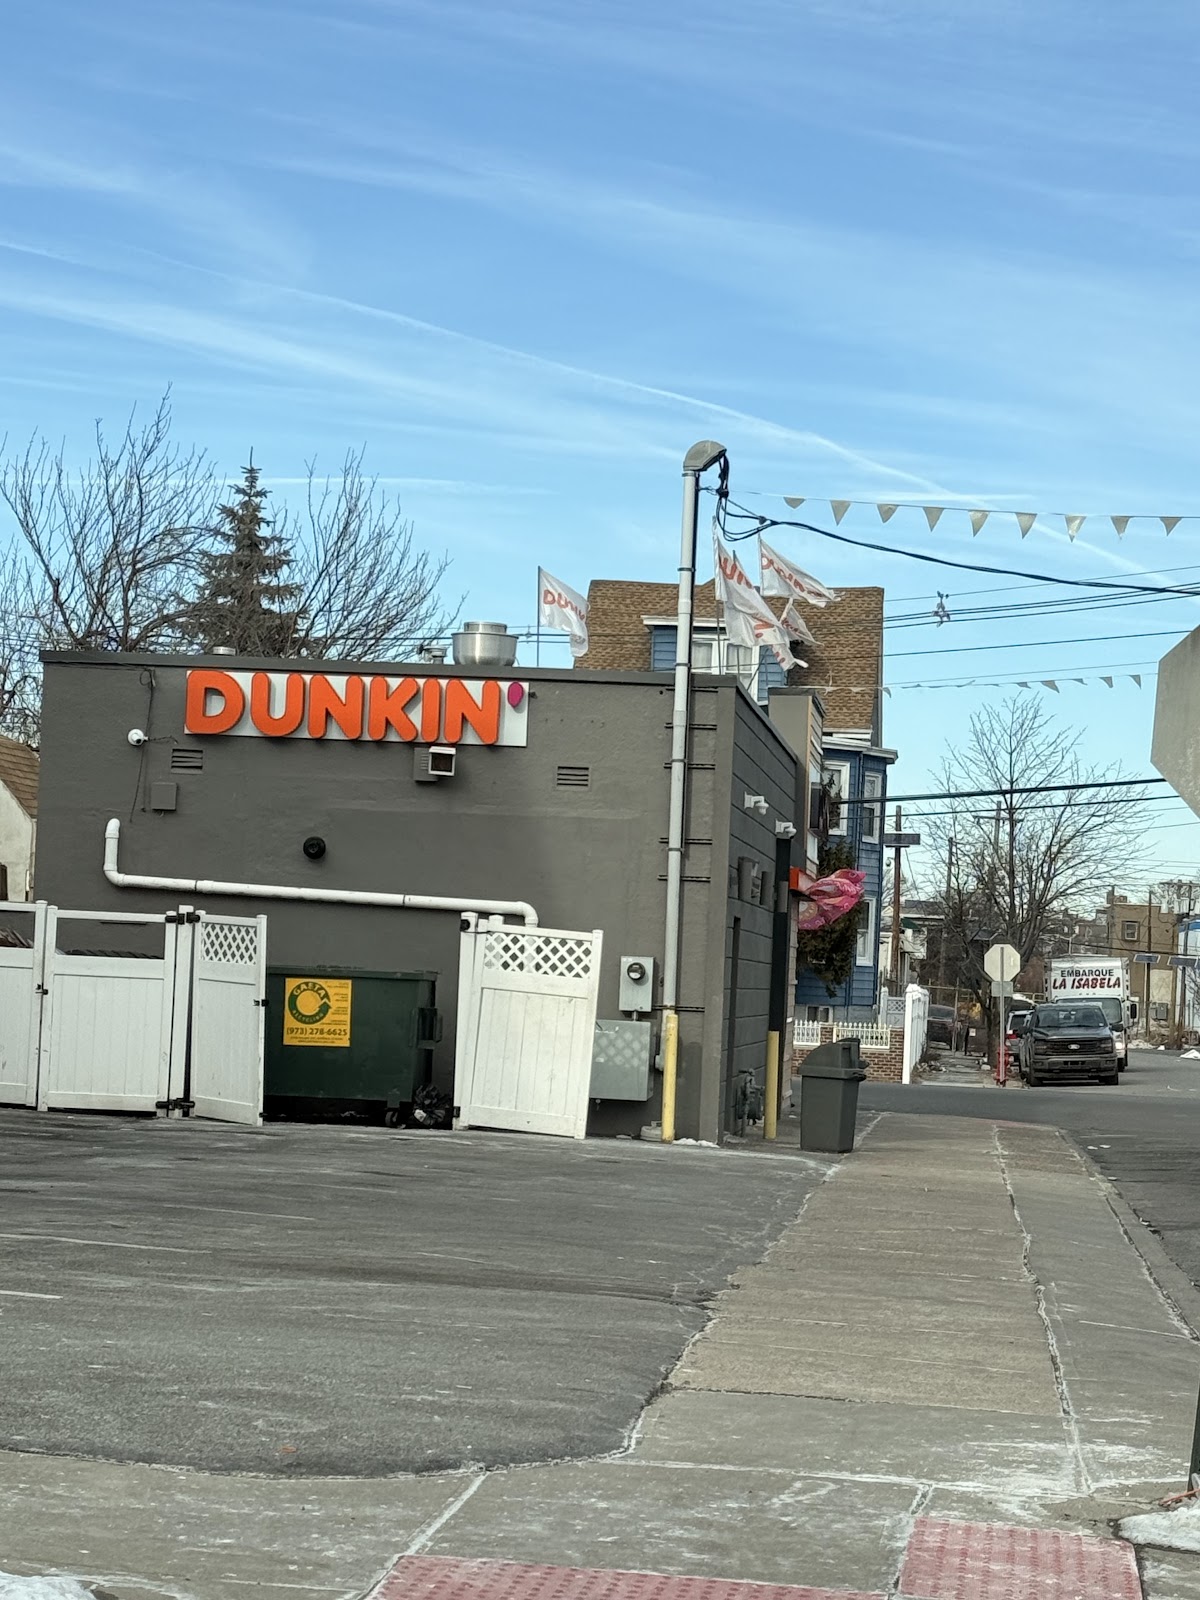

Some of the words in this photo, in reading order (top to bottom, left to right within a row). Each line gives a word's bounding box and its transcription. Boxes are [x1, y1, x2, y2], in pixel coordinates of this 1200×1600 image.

[1060, 968, 1115, 978] EMBARQUE
[1052, 977, 1067, 990] LA
[1070, 976, 1121, 990] ISABELA
[292, 982, 326, 998] GAETA
[286, 1027, 308, 1036] (973)
[309, 1027, 348, 1036] 278-6625
